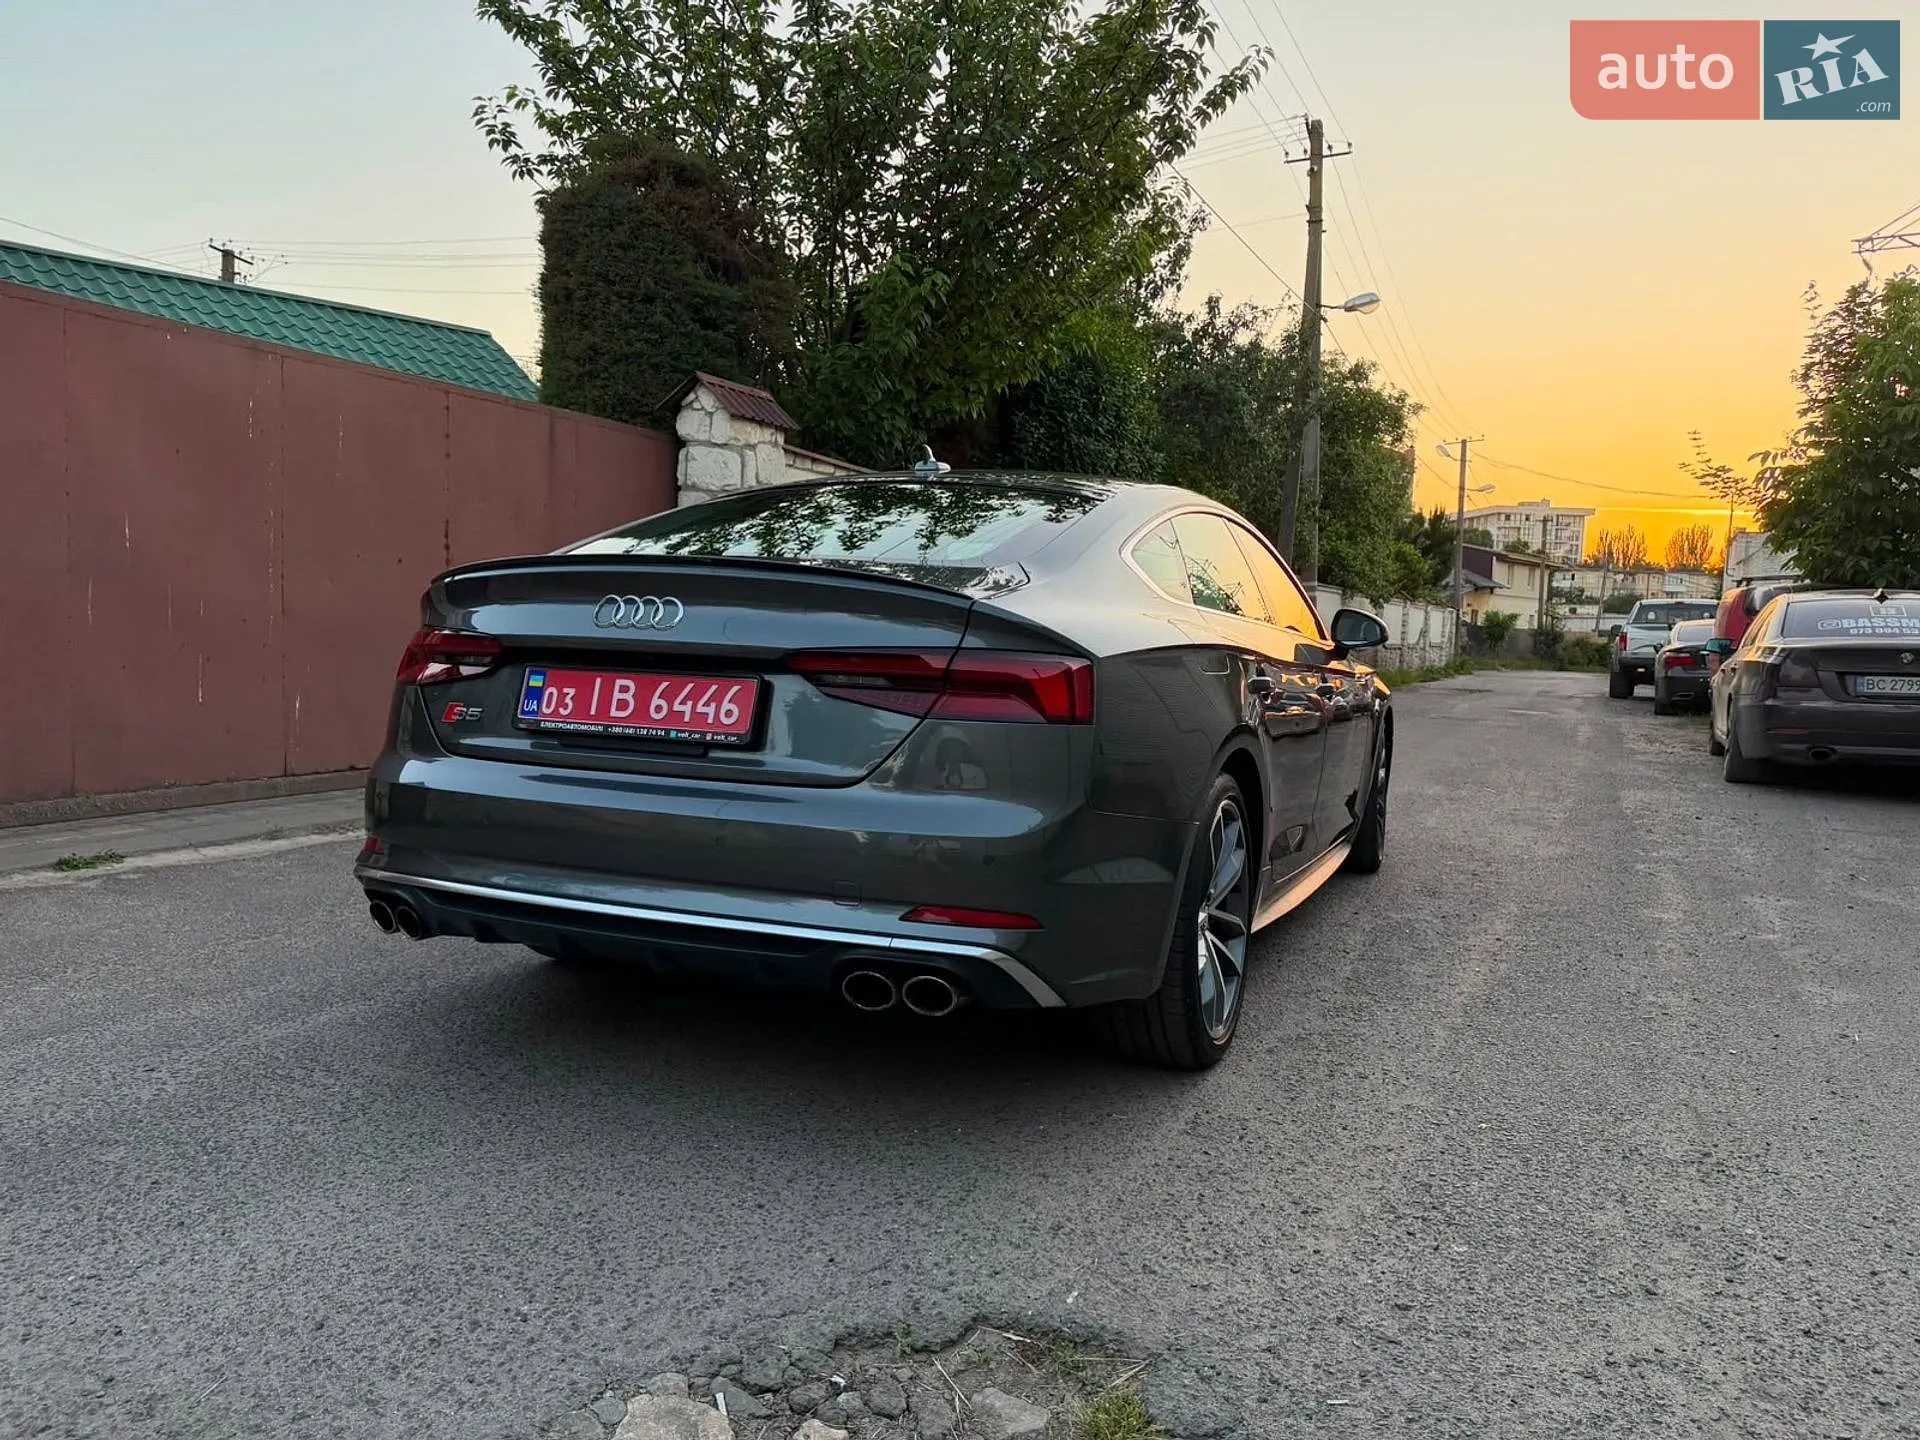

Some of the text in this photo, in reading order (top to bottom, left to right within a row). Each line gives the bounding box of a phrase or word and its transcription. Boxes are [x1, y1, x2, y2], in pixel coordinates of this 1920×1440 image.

[1866, 678, 1886, 690] BC
[523, 699, 538, 713] UA
[542, 677, 743, 726] 03 IB 6446
